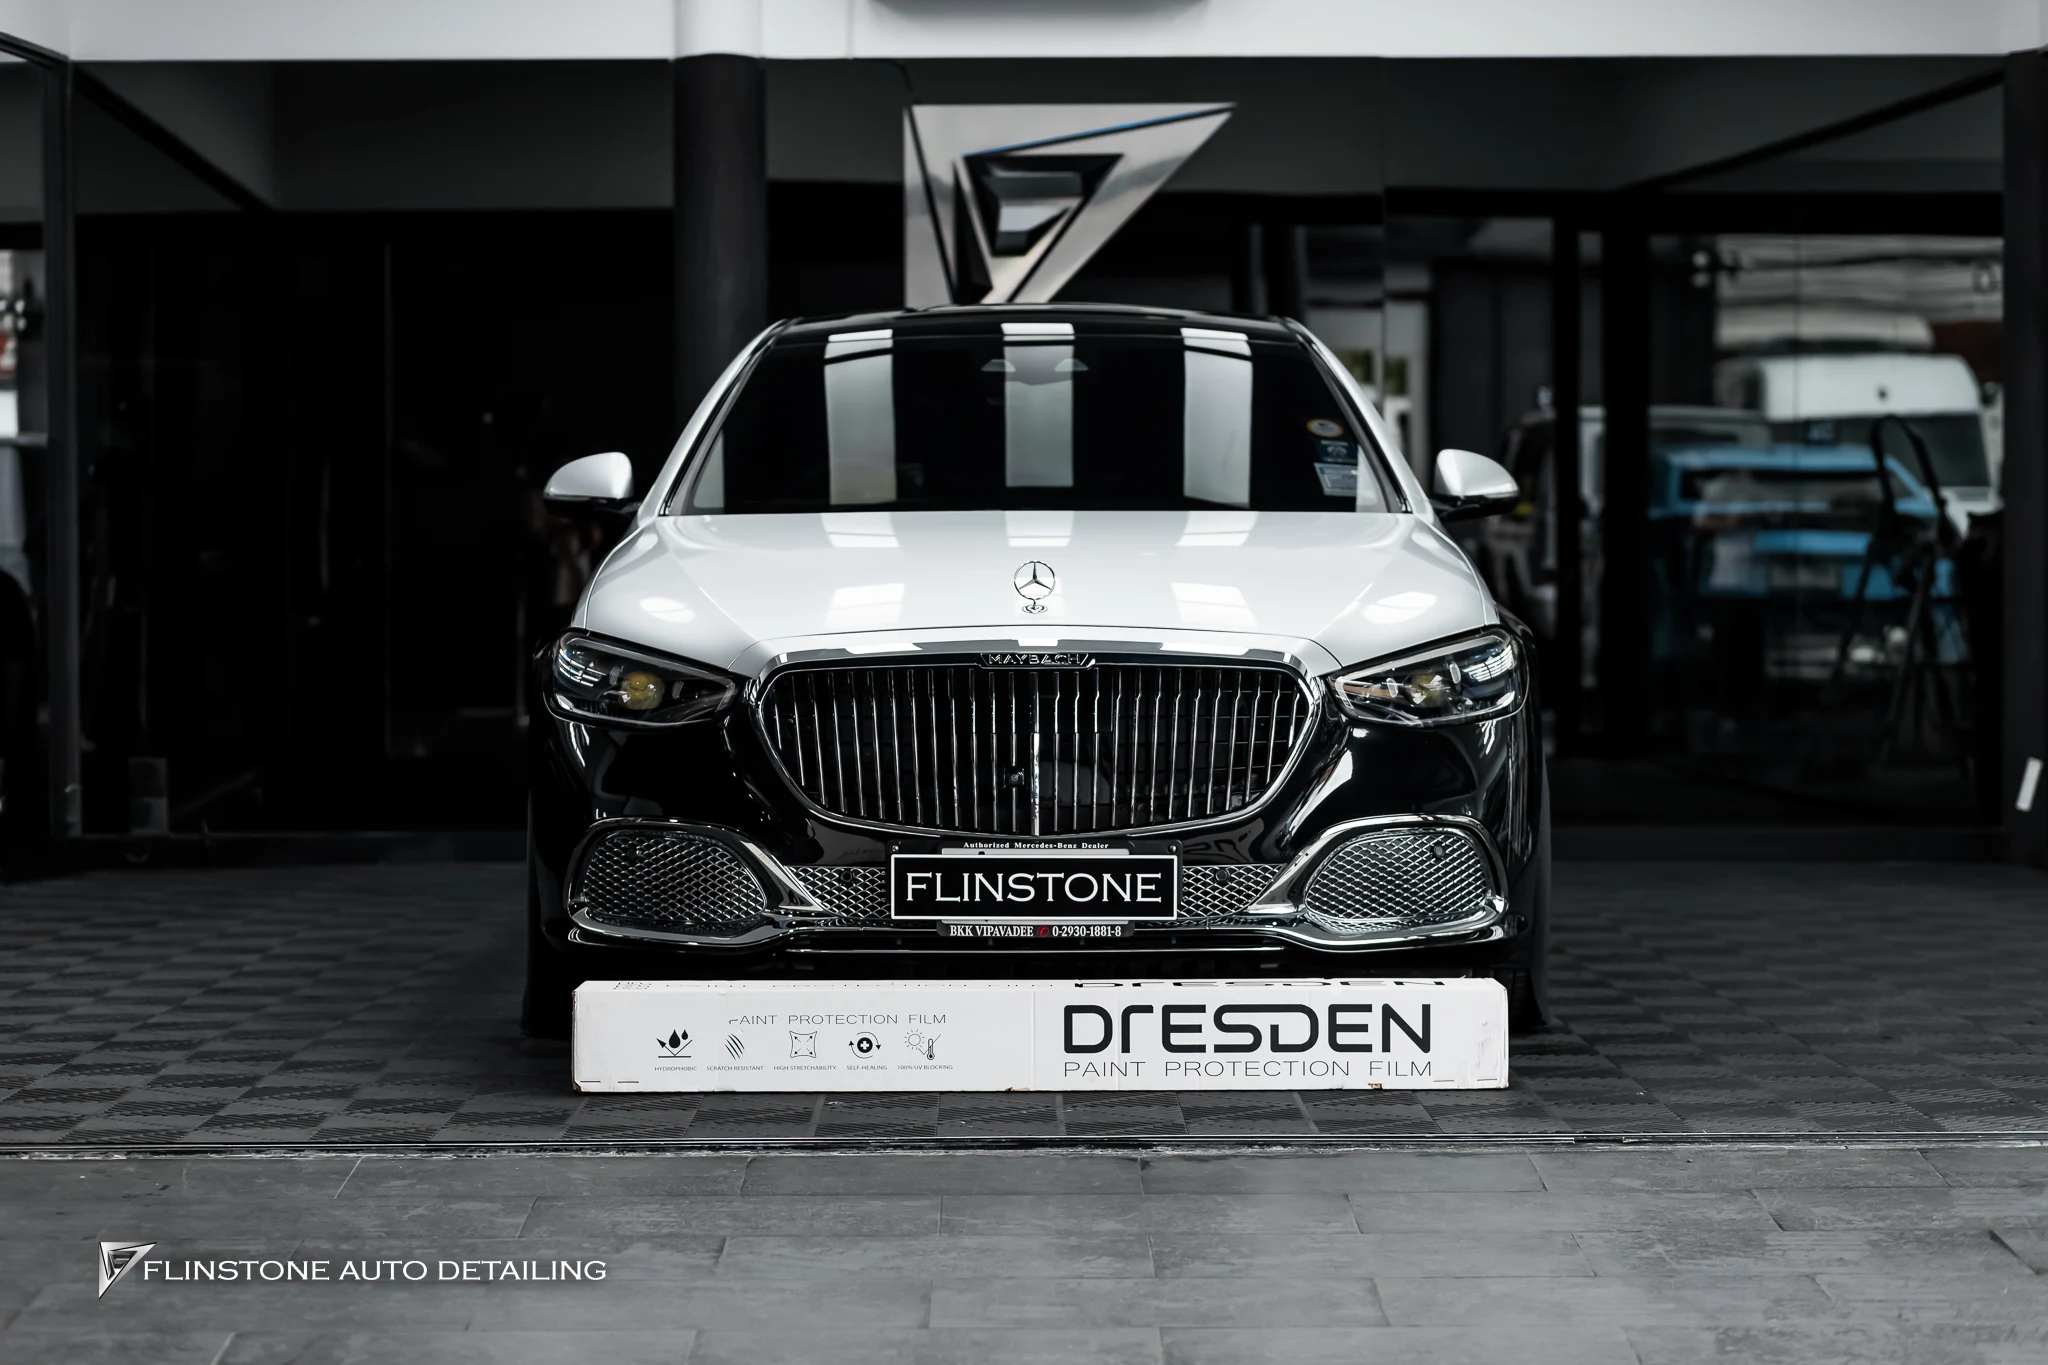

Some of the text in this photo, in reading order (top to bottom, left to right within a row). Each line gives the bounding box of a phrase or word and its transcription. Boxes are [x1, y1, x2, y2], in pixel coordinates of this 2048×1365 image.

[988, 653, 1081, 665] MAYBACH
[906, 871, 1162, 903] FLINSTONE
[950, 925, 1122, 937] BKK VIPAVADEE 0-2930-1881-8
[788, 1014, 898, 1025] PROTECTION
[908, 1014, 946, 1025] FILM
[1064, 1060, 1432, 1078] PAINT PROTECTION FILM
